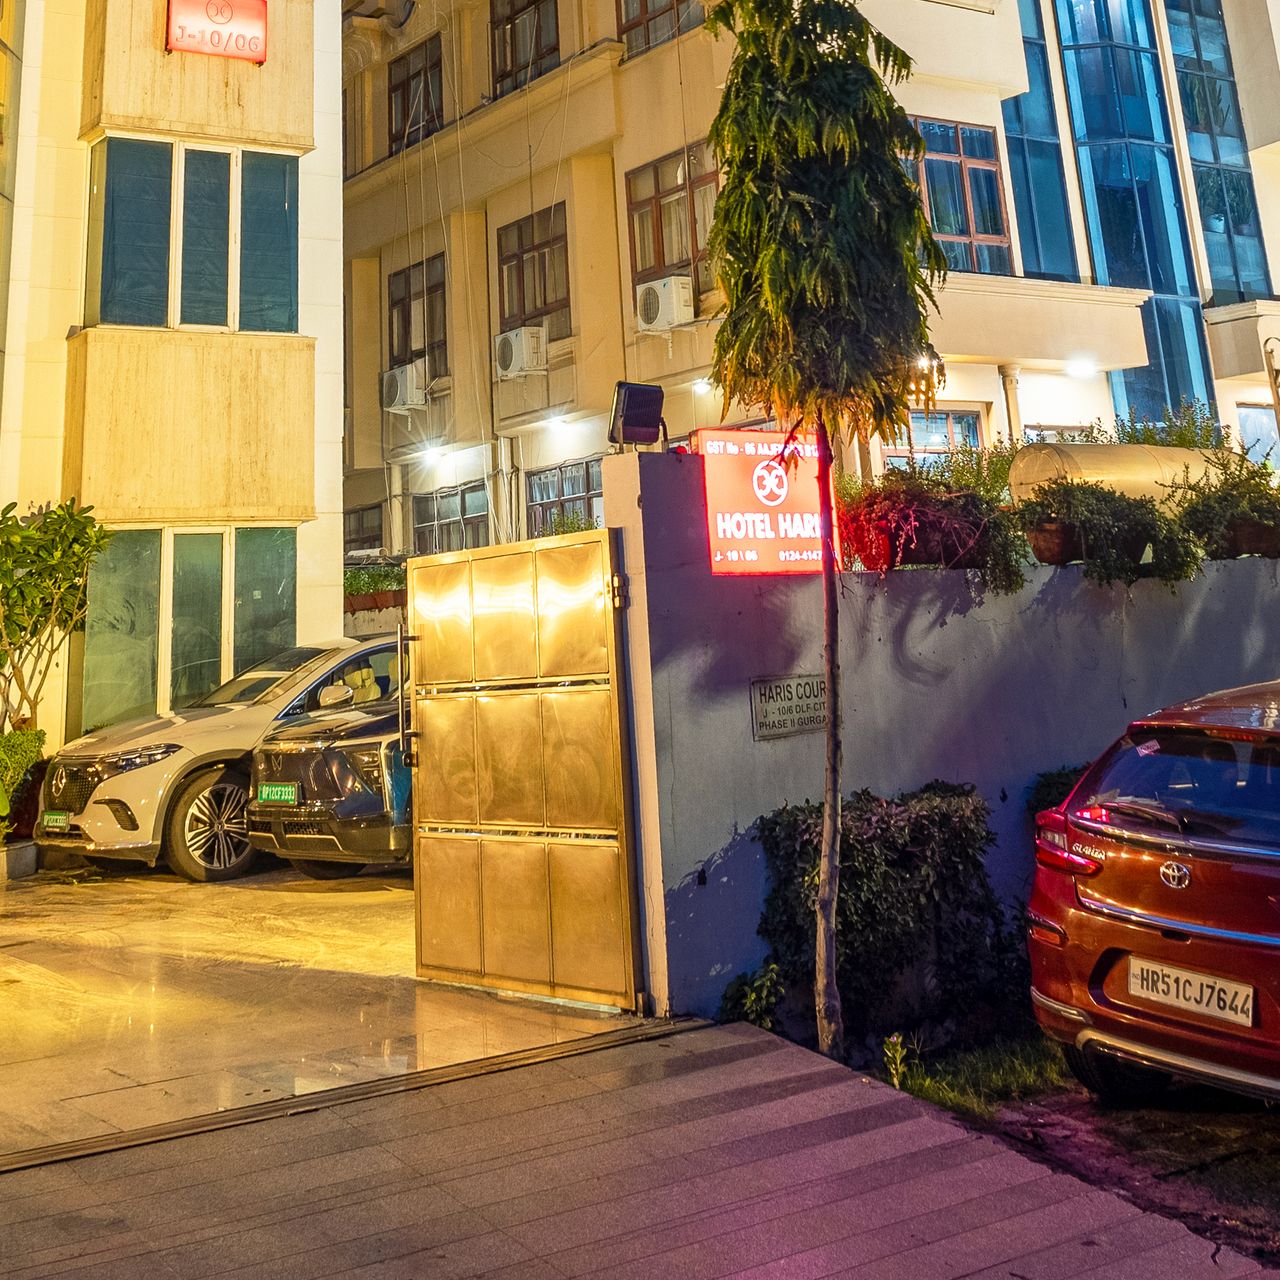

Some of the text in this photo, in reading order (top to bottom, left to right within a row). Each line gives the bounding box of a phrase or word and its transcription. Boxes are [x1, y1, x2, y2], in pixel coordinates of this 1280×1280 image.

[706, 440, 724, 455] GST
[716, 512, 821, 539] HOTEL HARI
[759, 680, 827, 704] HARIS COUR
[763, 709, 768, 718] J
[777, 705, 793, 715] 10/6
[796, 702, 811, 714] DLF
[813, 701, 826, 712] CIT
[759, 719, 788, 731] PHASE
[1140, 967, 1250, 1019] HR51CJ7644
